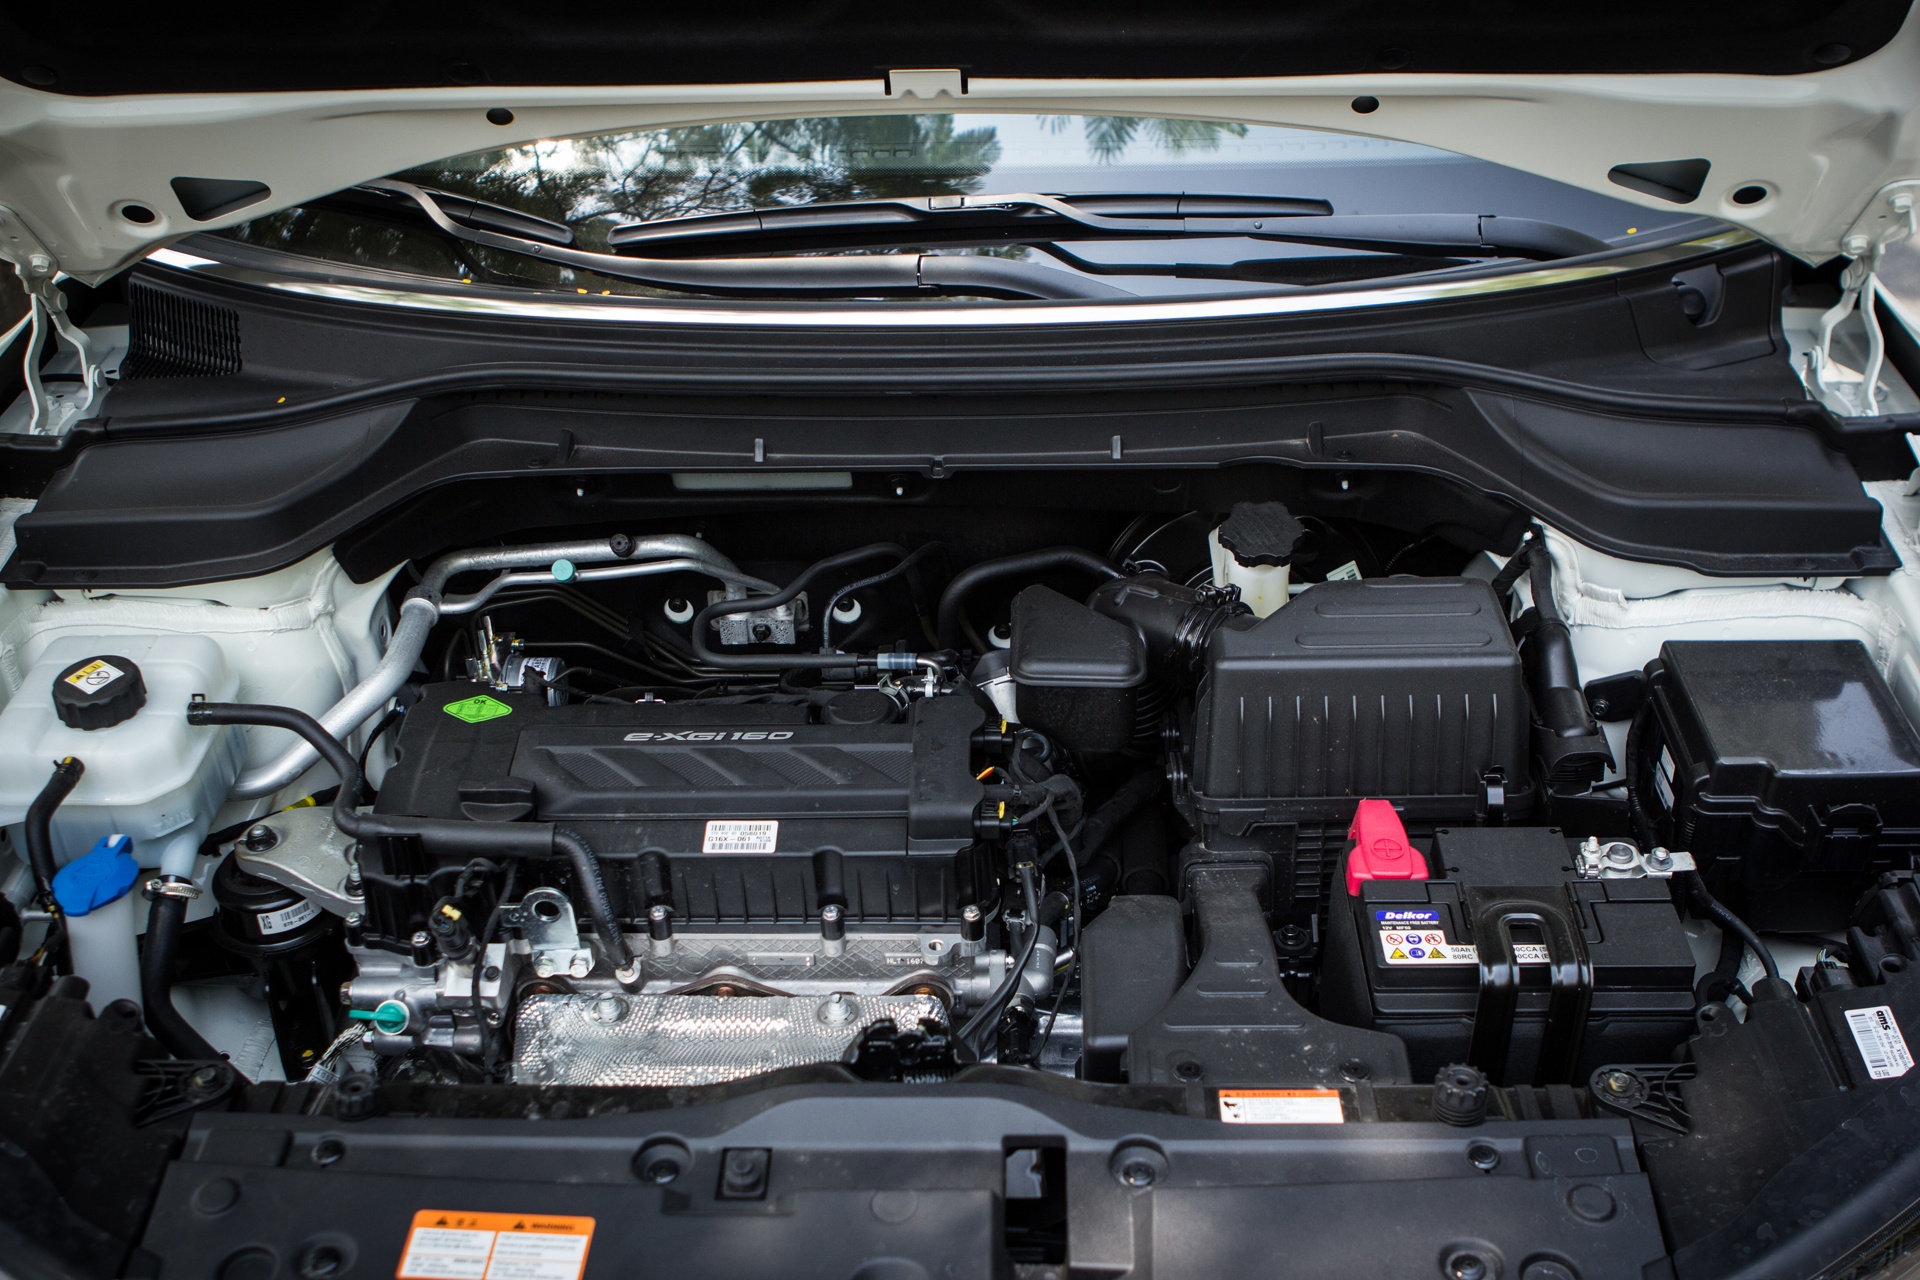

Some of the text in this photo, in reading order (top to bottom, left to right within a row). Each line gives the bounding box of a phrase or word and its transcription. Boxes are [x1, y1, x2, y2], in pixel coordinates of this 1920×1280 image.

[730, 731, 794, 741] 160
[1384, 911, 1433, 920] Delkor
[1876, 1010, 1891, 1031] ams
